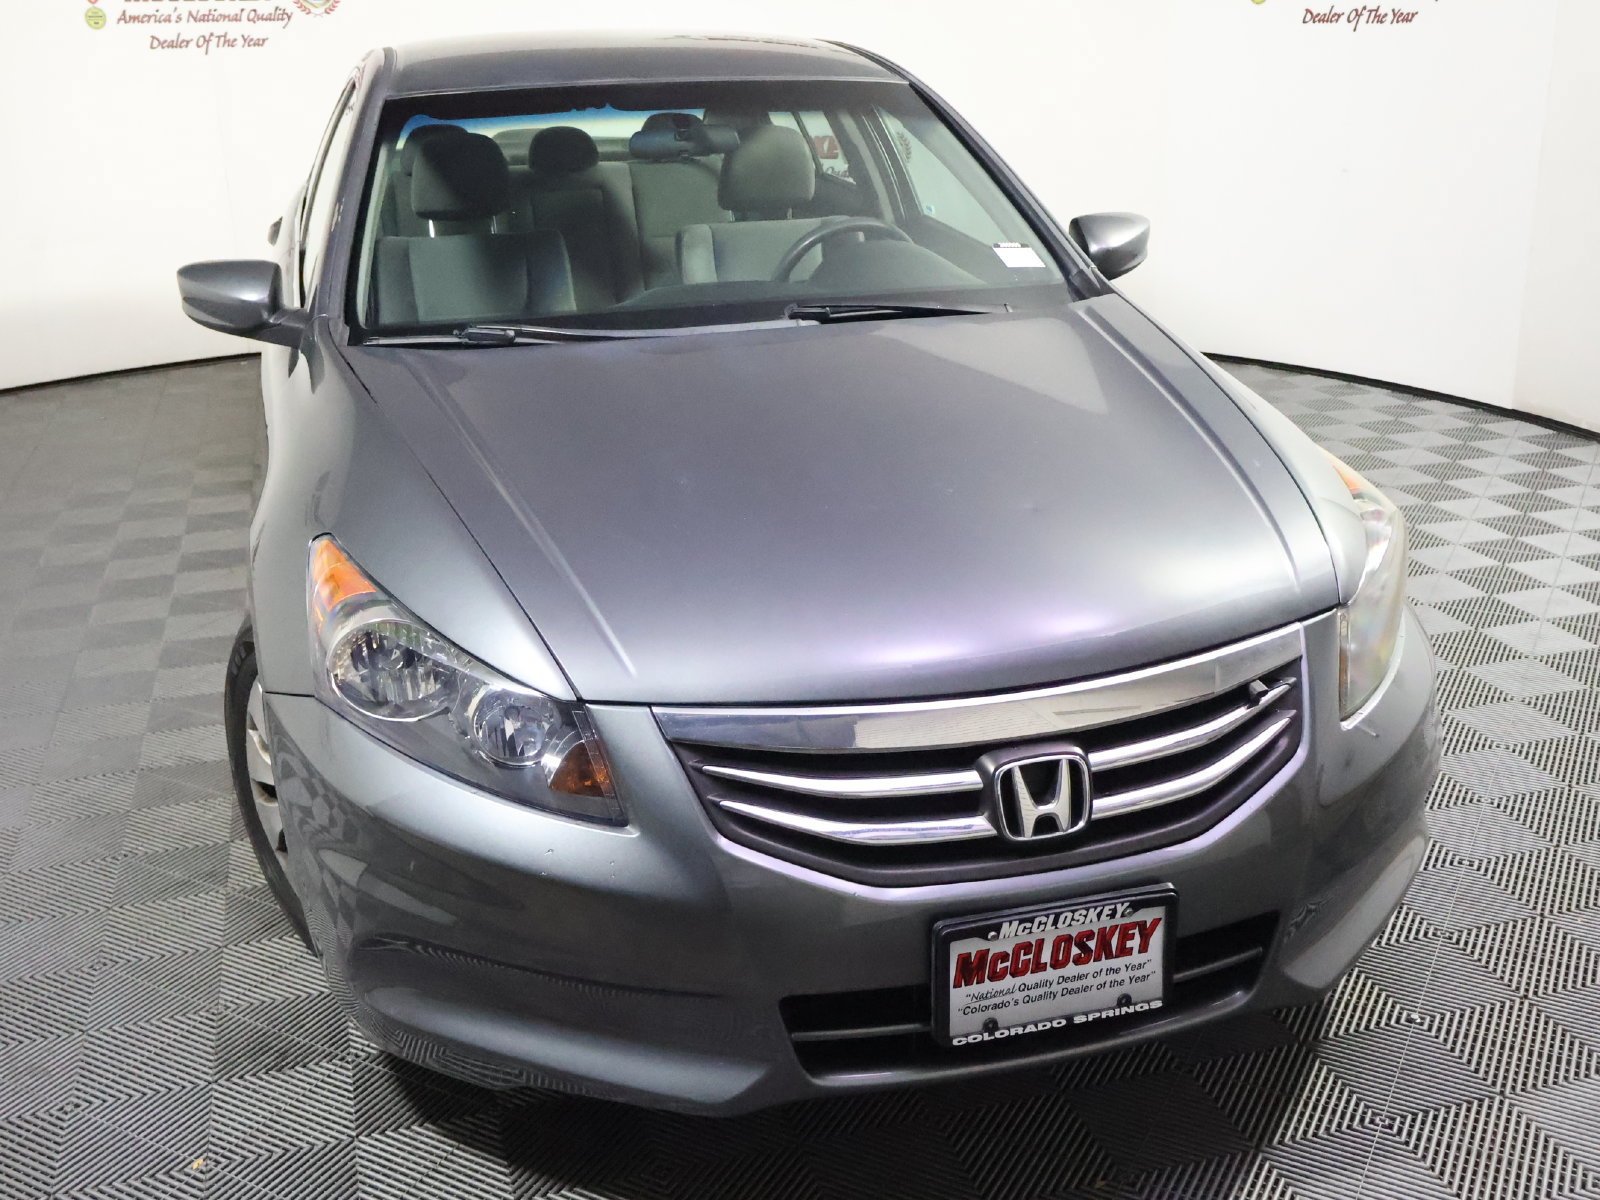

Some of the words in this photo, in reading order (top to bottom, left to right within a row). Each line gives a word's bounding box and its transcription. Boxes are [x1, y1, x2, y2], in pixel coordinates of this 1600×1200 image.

[117, 7, 183, 24] America's
[187, 8, 246, 23] National
[246, 6, 293, 29] Quality
[1302, 6, 1344, 24] Dealer
[1346, 5, 1367, 32] Of
[1366, 5, 1387, 24] The
[1389, 8, 1419, 24] Year
[150, 33, 193, 49] Dealer
[196, 32, 214, 55] Of
[215, 32, 237, 48] The
[241, 34, 269, 48] Year
[953, 917, 1162, 989] McCLOSKEY
[1018, 978, 1055, 994] Quality
[1056, 972, 1090, 986] Dealer
[1092, 969, 1103, 979] of
[1105, 966, 1121, 977] the
[1022, 990, 1059, 1006] Quality
[1060, 984, 1094, 998] Dealer
[1096, 981, 1107, 992] of
[1109, 978, 1125, 989] the
[952, 1018, 1067, 1046] COLORADO
[1073, 1000, 1164, 1024] SPRINGS
